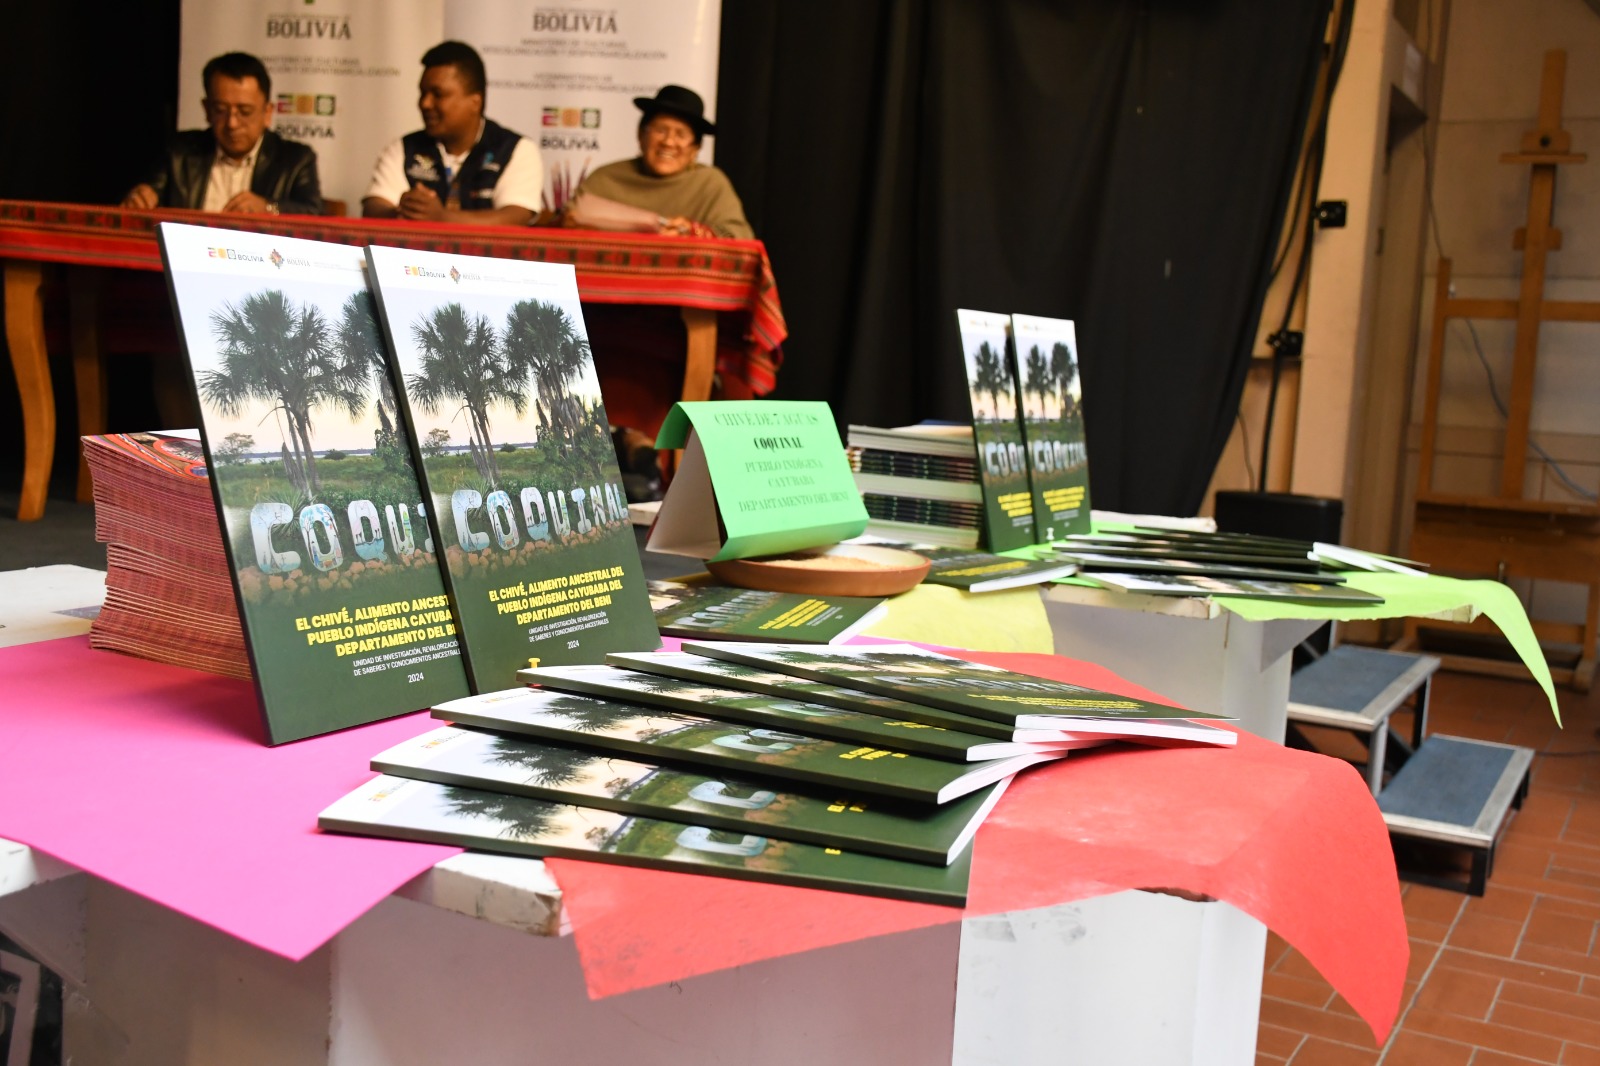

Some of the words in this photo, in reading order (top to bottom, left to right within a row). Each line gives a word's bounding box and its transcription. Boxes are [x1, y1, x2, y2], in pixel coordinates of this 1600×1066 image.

[266, 20, 352, 39] BOLIVIA
[533, 13, 618, 33] BOLIVIA
[541, 136, 599, 150] BOLIVIA
[238, 254, 264, 263] BOLIVIA
[754, 436, 804, 452] COQUINAL
[738, 494, 813, 512] DEPARTAMENTO
[452, 482, 628, 552] COQUINAL
[488, 590, 500, 602] EL
[500, 582, 528, 600] CHIVÉ,
[528, 576, 568, 594] ALIMENTO
[570, 568, 611, 587] ANCESTRAL
[611, 566, 624, 578] DEL
[497, 600, 528, 614] PUEBLO
[529, 592, 568, 608] INDÍGENA
[568, 583, 609, 600] CAYUBABA
[608, 579, 623, 592] DEL
[296, 617, 311, 632] EL
[312, 607, 354, 628] CHIVÉ,
[355, 601, 410, 622] ALIMENTO
[412, 594, 450, 612] ANCEST
[516, 601, 580, 626] DEPARTAMENTO
[580, 599, 594, 611] DEL
[594, 594, 612, 608] BENI
[307, 627, 354, 646] PUEBLO
[355, 617, 410, 637] INDÍGENA
[410, 609, 452, 627] CAYUBA
[336, 628, 426, 656] DEPARTAMENTO
[426, 626, 446, 640] DEL
[352, 658, 375, 668] UNIDAD
[374, 655, 382, 663] DE
[382, 647, 422, 661] INVESTIGACIÓN,
[422, 639, 458, 652] REVALORIZACIÓ
[567, 640, 580, 650] 2024
[354, 668, 362, 676] DE
[362, 664, 386, 674] SABERES
[391, 654, 432, 668] CONOCIMIENTOS
[432, 649, 461, 660] ANCESTRAL
[408, 672, 424, 683] 2024
